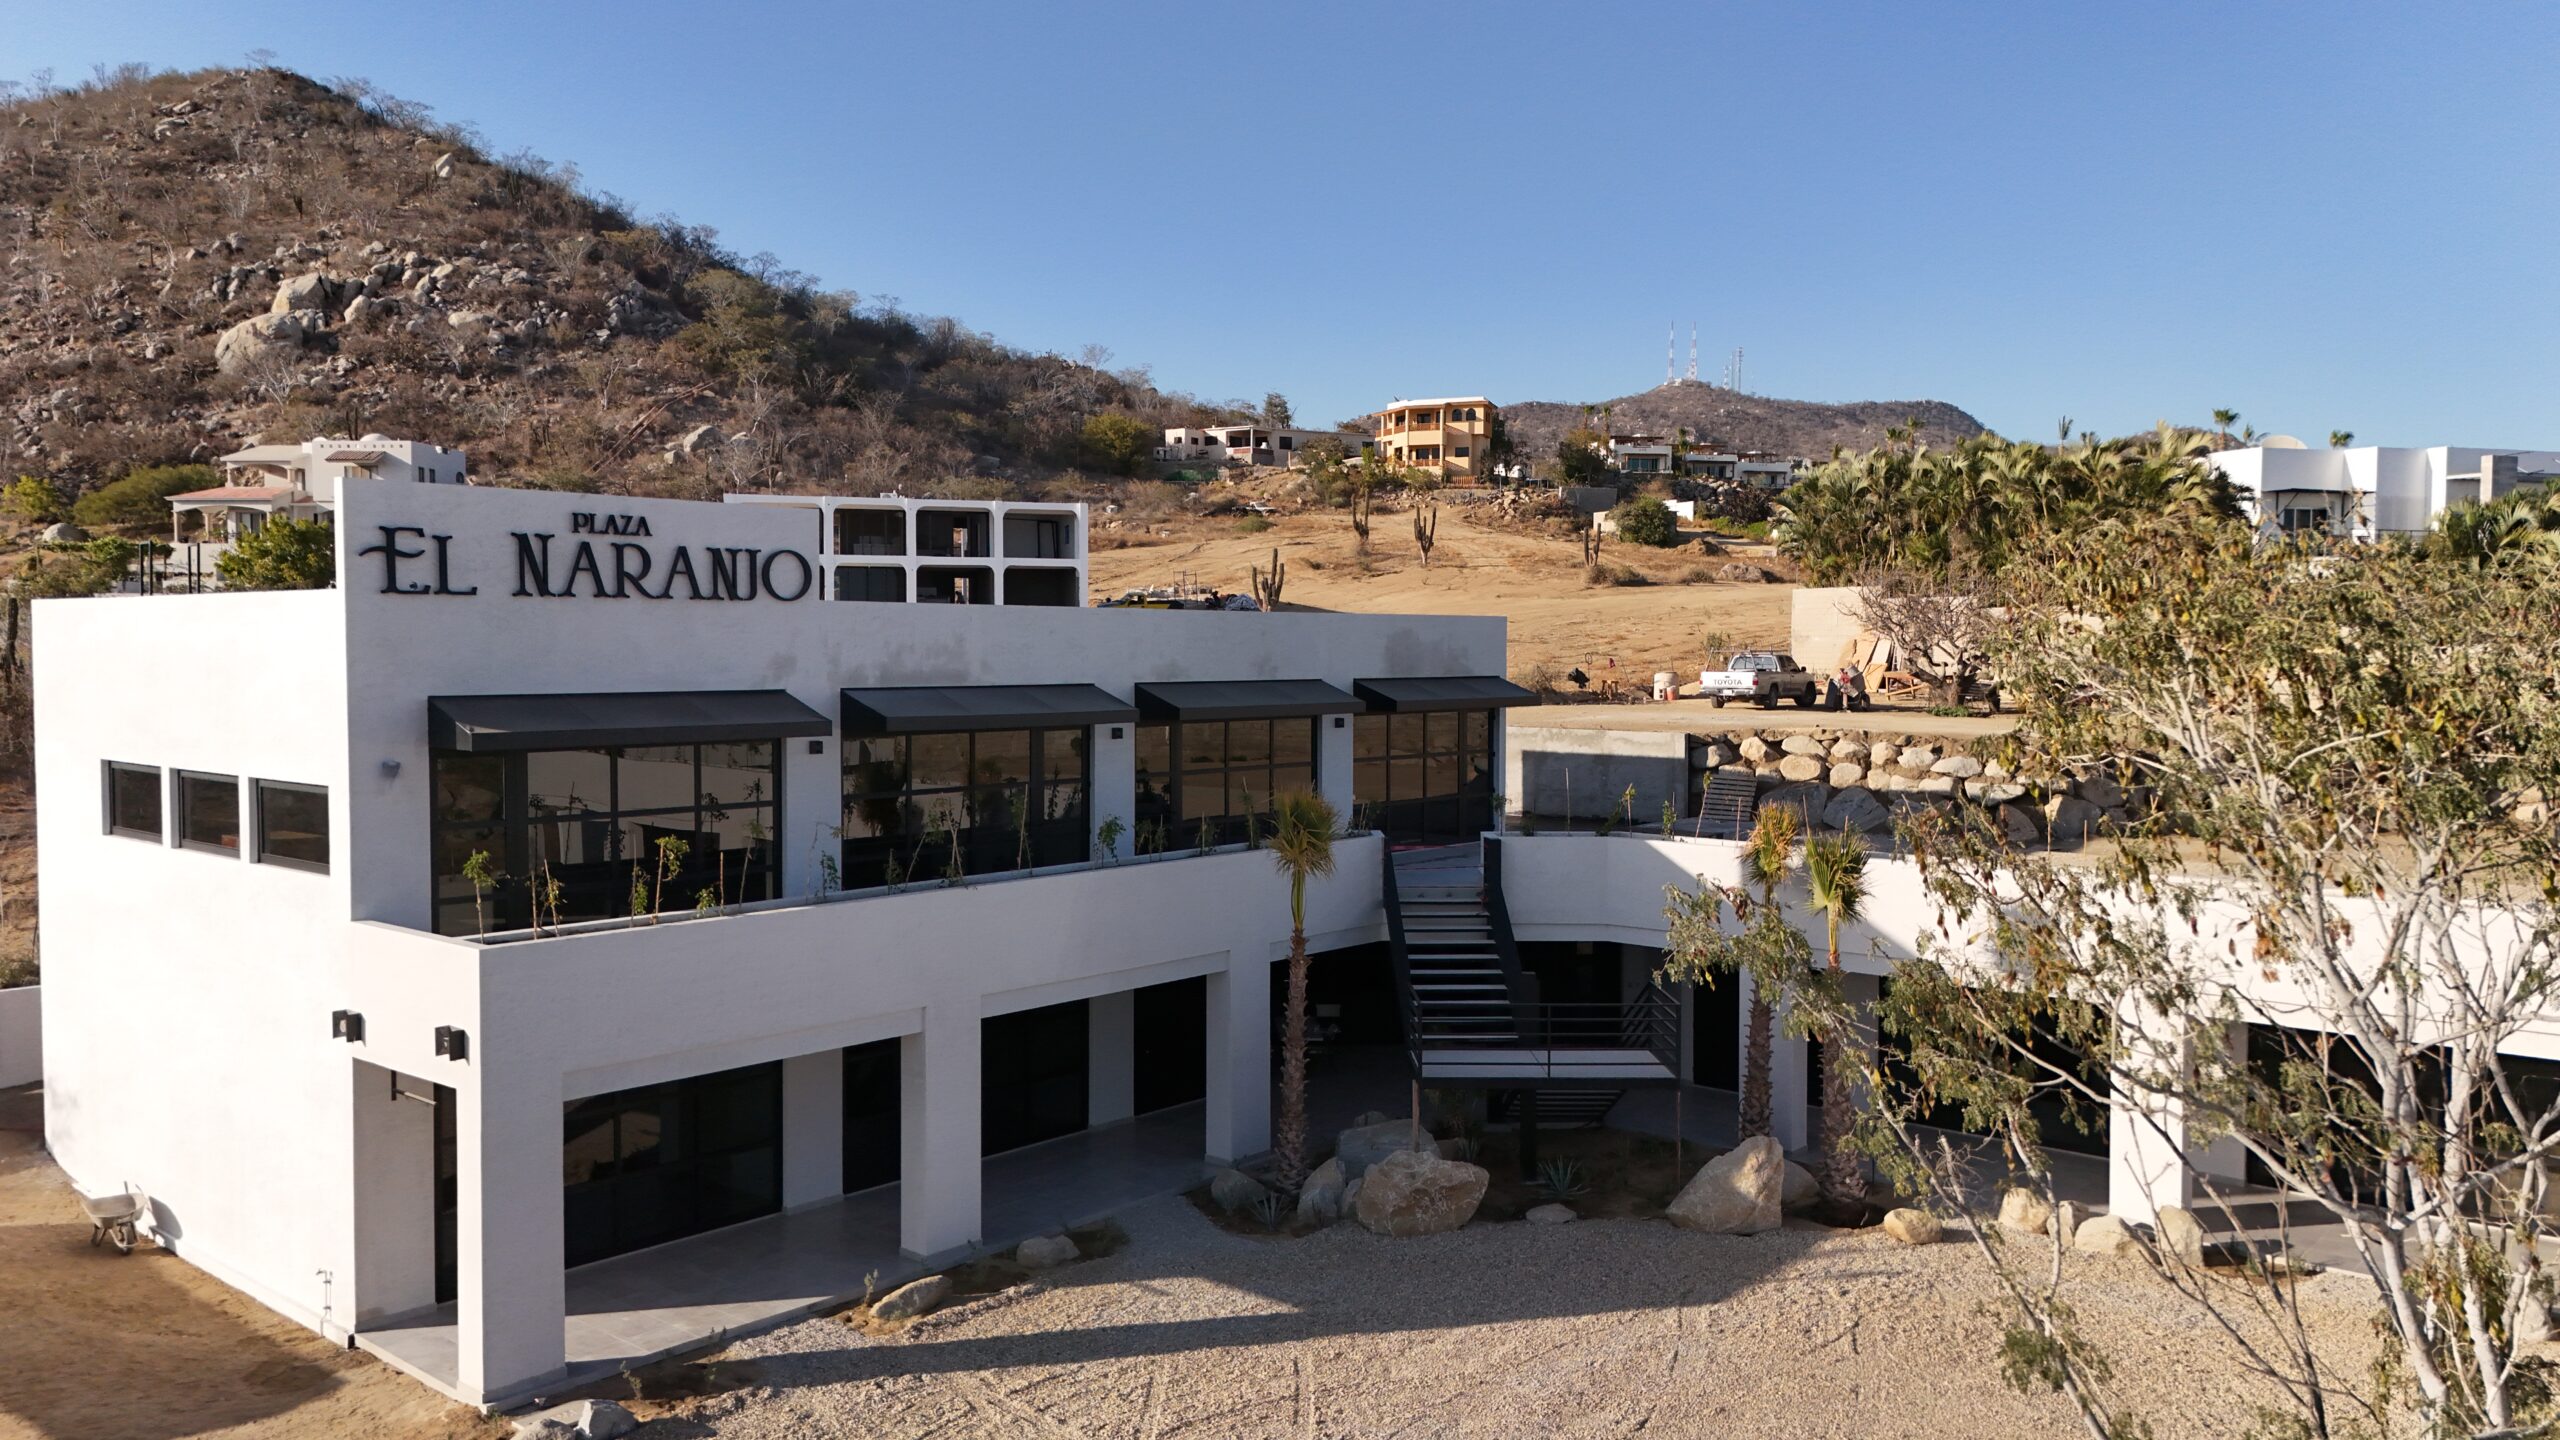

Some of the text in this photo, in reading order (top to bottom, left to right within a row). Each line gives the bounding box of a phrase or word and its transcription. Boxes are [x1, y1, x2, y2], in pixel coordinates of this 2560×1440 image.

[572, 512, 653, 537] PLAZA
[358, 525, 813, 602] EL NARANJO
